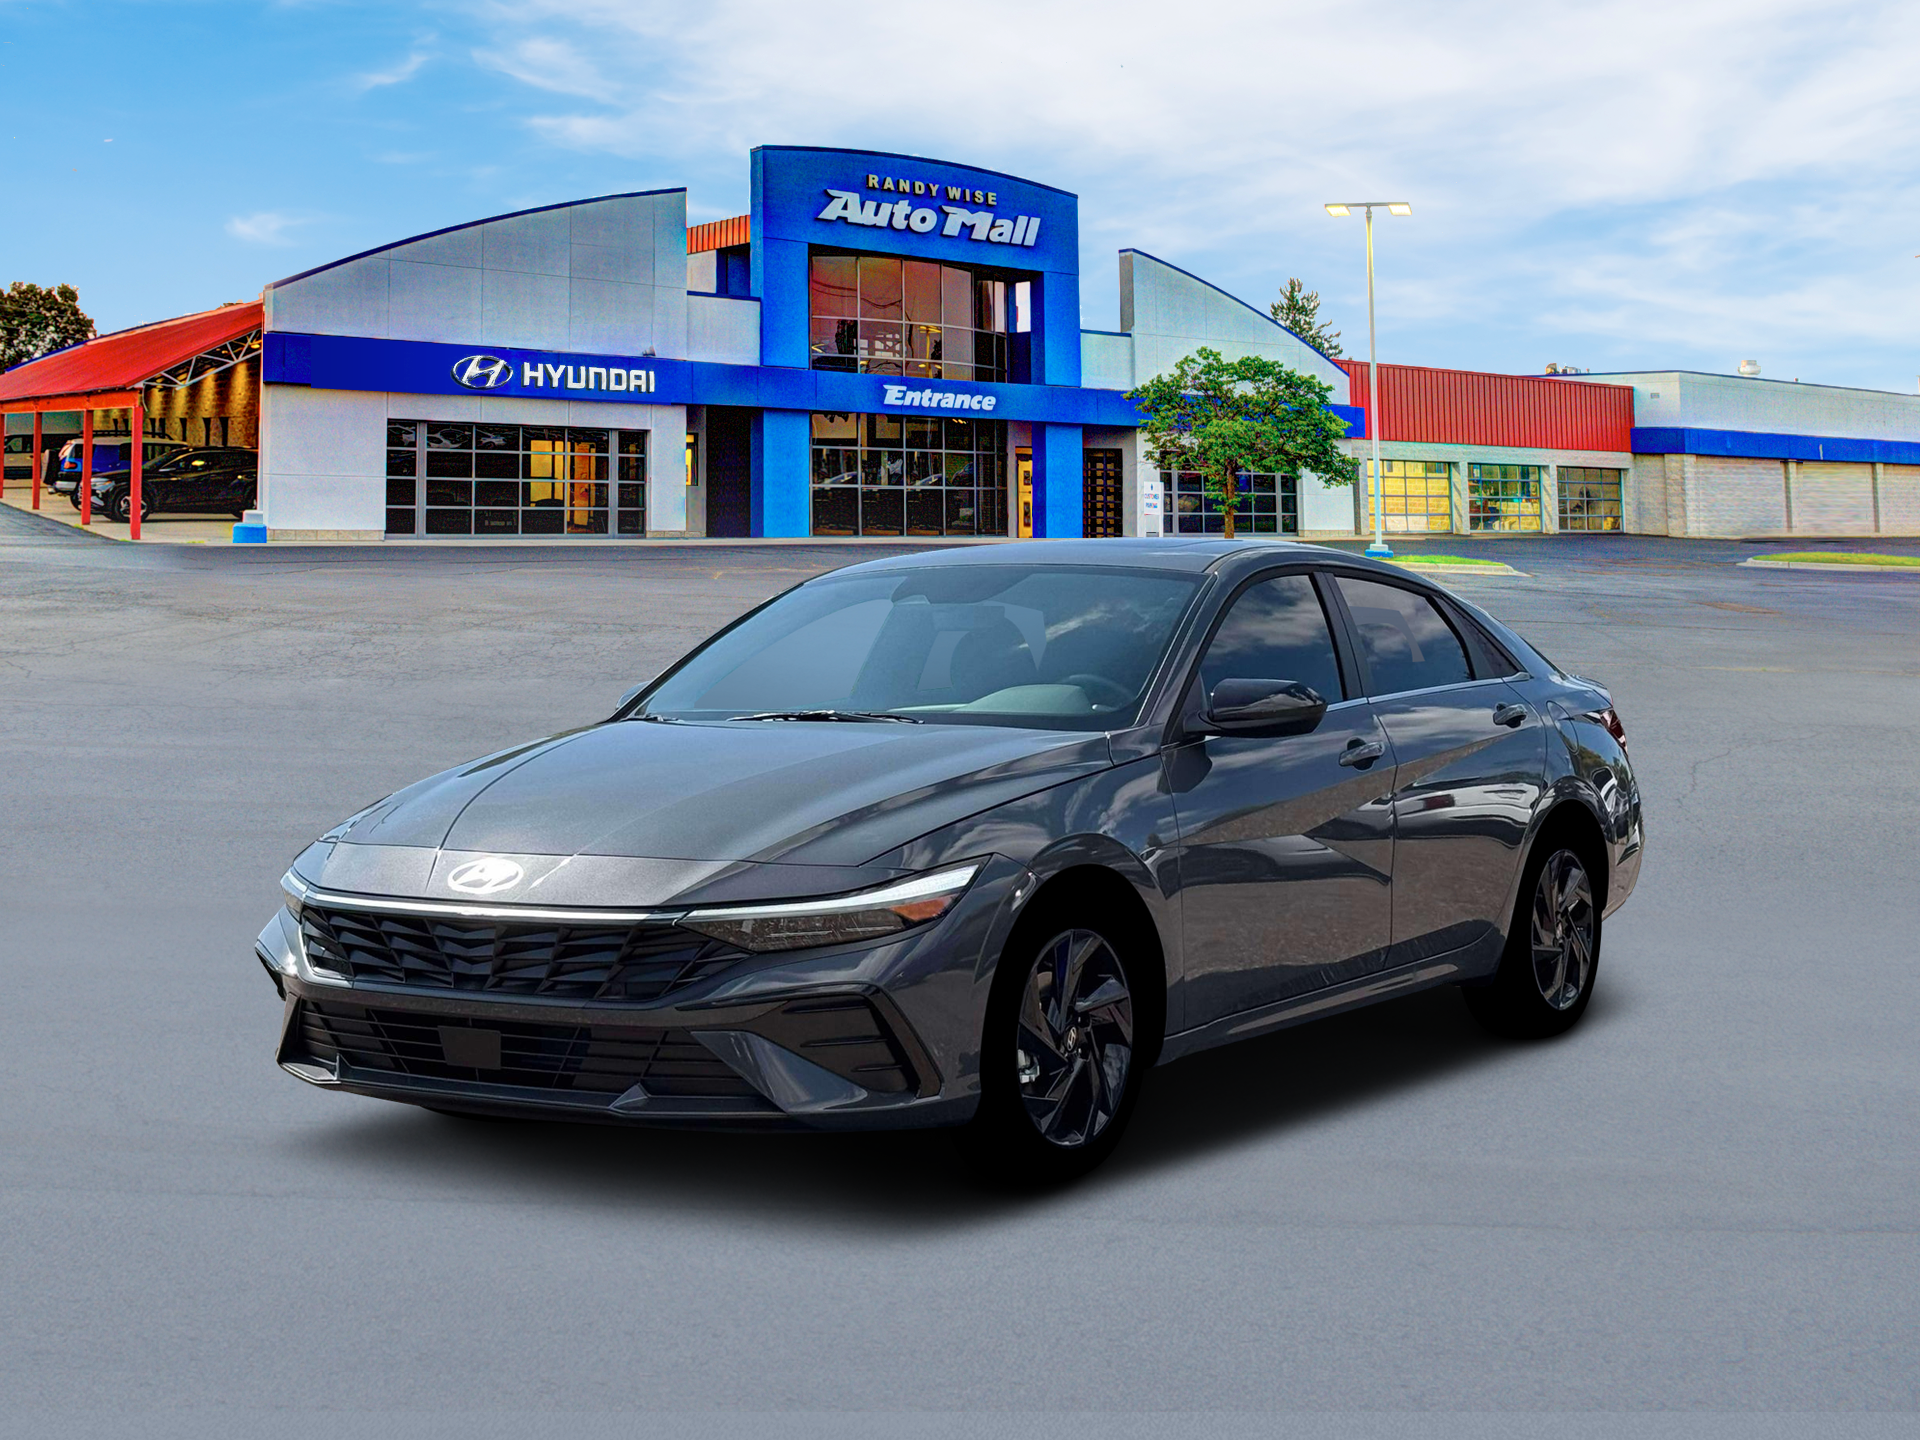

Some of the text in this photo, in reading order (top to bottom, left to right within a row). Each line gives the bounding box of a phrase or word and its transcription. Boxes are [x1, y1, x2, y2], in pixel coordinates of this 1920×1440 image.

[867, 173, 997, 206] RANDY WISE
[817, 188, 1041, 247] Auto Mall
[521, 361, 655, 393] HYUNDAI
[882, 384, 996, 411] Entrance
